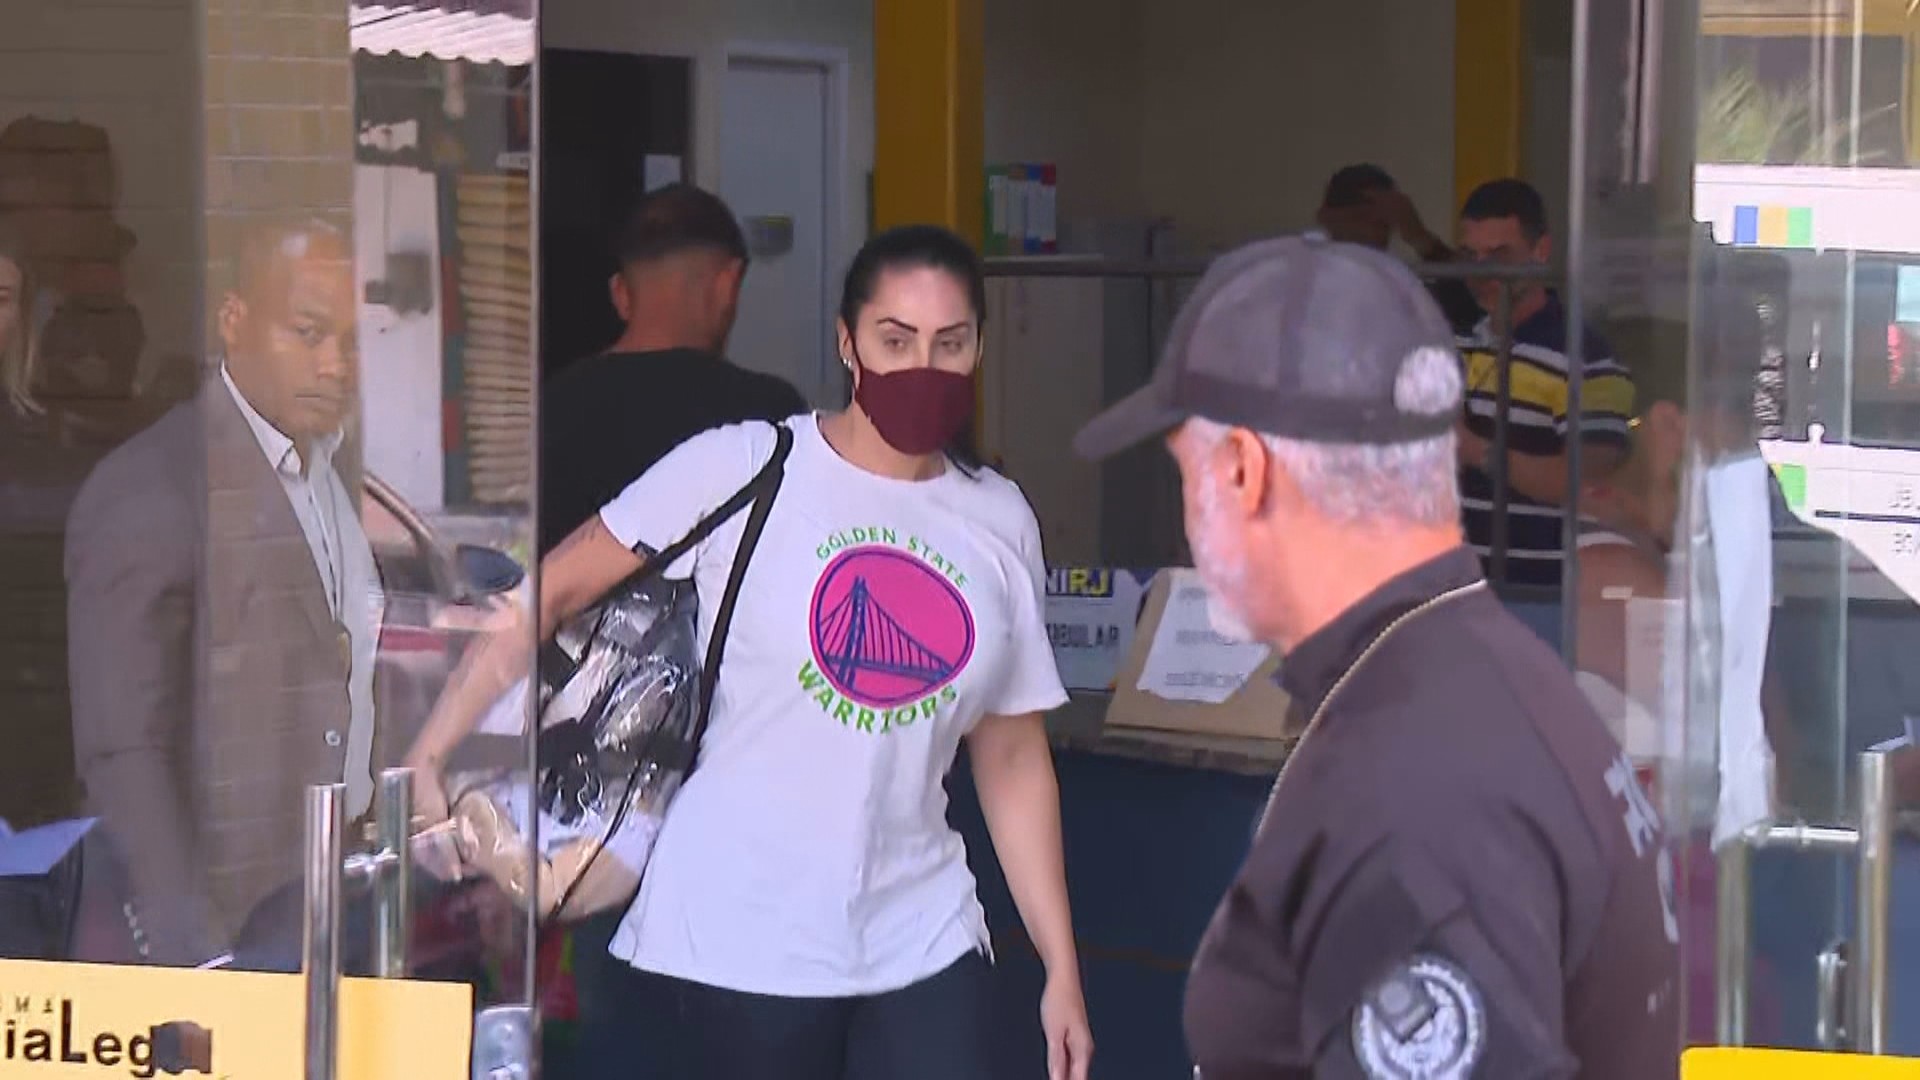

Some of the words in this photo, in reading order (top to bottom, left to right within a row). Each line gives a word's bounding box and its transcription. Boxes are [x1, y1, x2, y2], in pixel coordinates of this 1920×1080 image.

[815, 527, 897, 560] GOLDEN
[907, 534, 968, 588] STATE
[798, 658, 957, 734] WARRIORS
